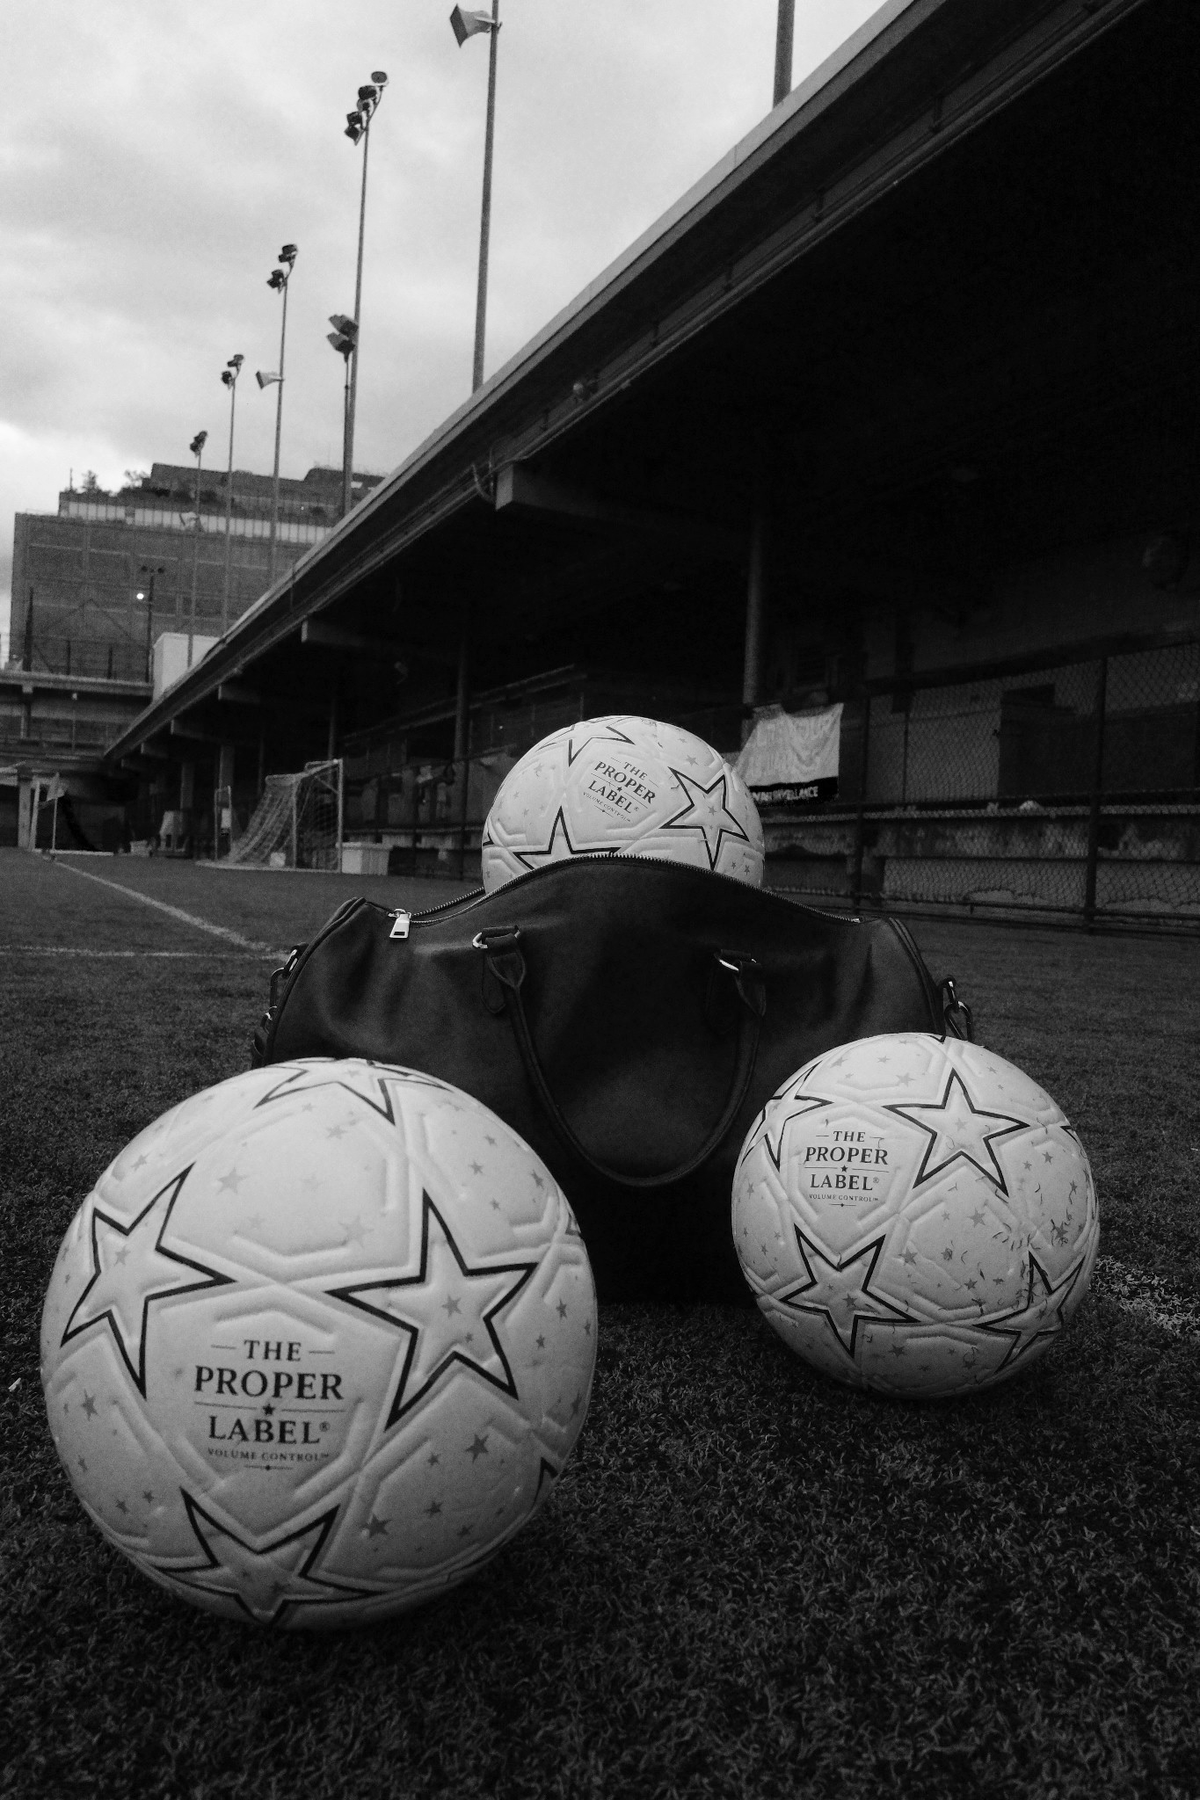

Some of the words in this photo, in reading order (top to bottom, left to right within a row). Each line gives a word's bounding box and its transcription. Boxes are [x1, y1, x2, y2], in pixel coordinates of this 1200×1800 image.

[624, 761, 648, 781] THE
[594, 760, 656, 804] PROPER
[832, 1130, 866, 1143] THE
[804, 1146, 889, 1166] PROPER
[808, 1193, 836, 1201] VOLUME
[243, 1339, 302, 1362] THE
[194, 1365, 345, 1400] PROPER
[207, 1447, 257, 1461] VOLUME
